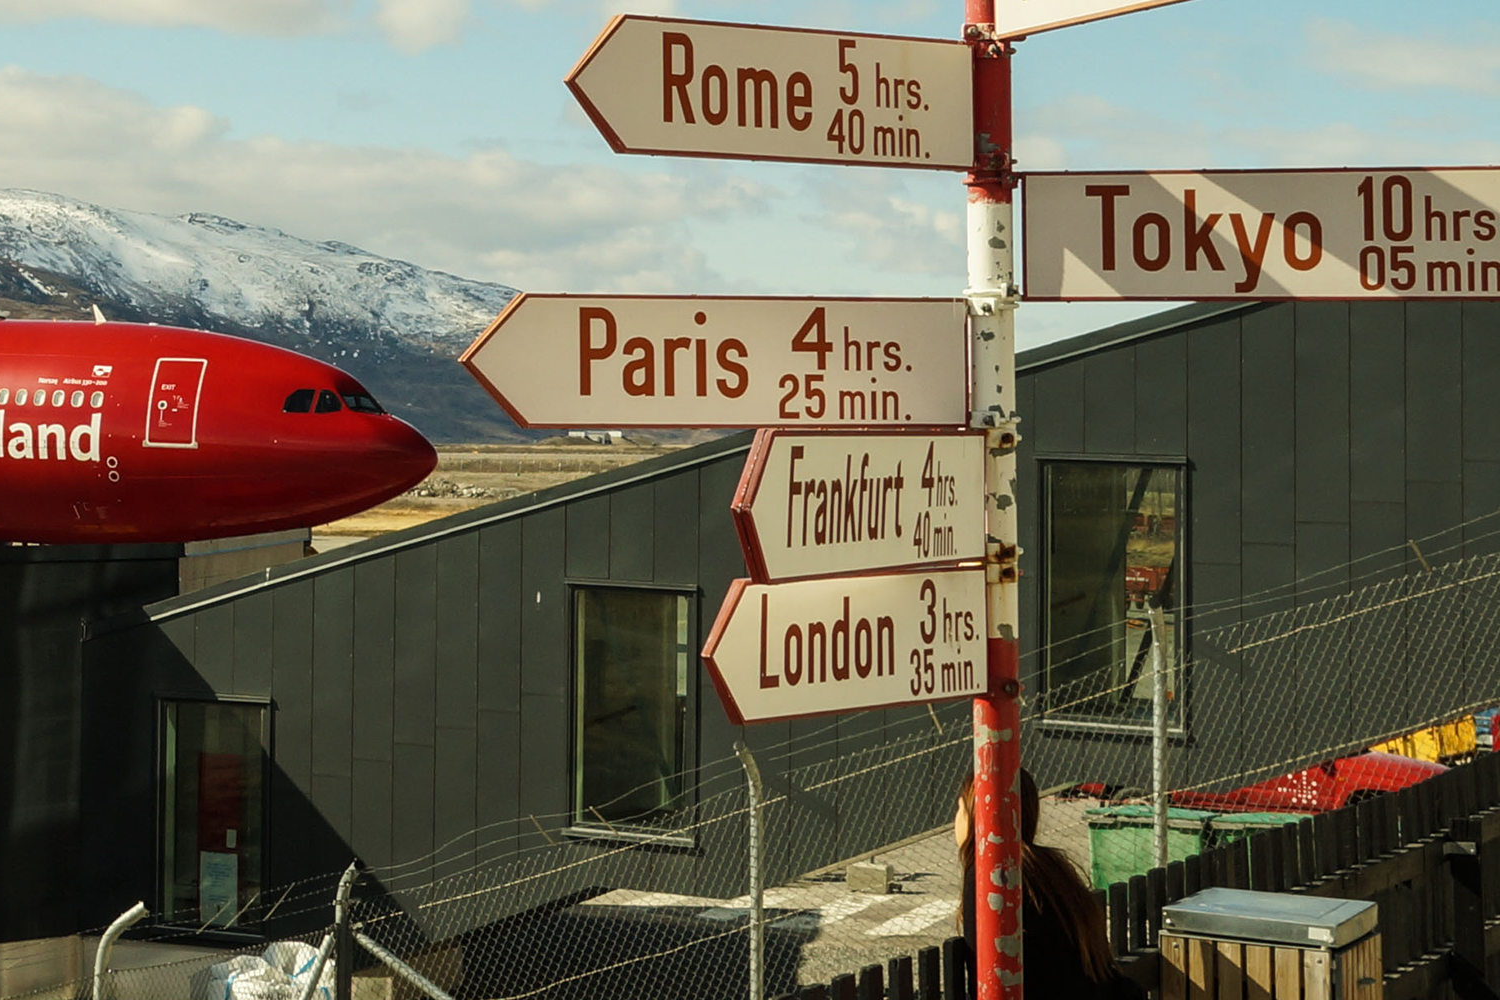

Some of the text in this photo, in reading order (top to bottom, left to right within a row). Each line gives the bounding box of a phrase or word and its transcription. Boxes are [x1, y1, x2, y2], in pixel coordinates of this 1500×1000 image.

[662, 31, 929, 131] Rome 5 hrs.
[827, 109, 931, 159] 40 min.
[1085, 175, 1497, 293] Tokyo 10 hrs
[1359, 246, 1416, 291] 05
[579, 306, 913, 398] Paris 4 hrs.
[778, 374, 912, 421] 25 min.
[787, 441, 958, 548] Frankfurt 4 hrs.
[913, 510, 958, 559] 40 min.
[760, 579, 980, 689] London 3 hrs.
[910, 647, 980, 696] 35 min.
